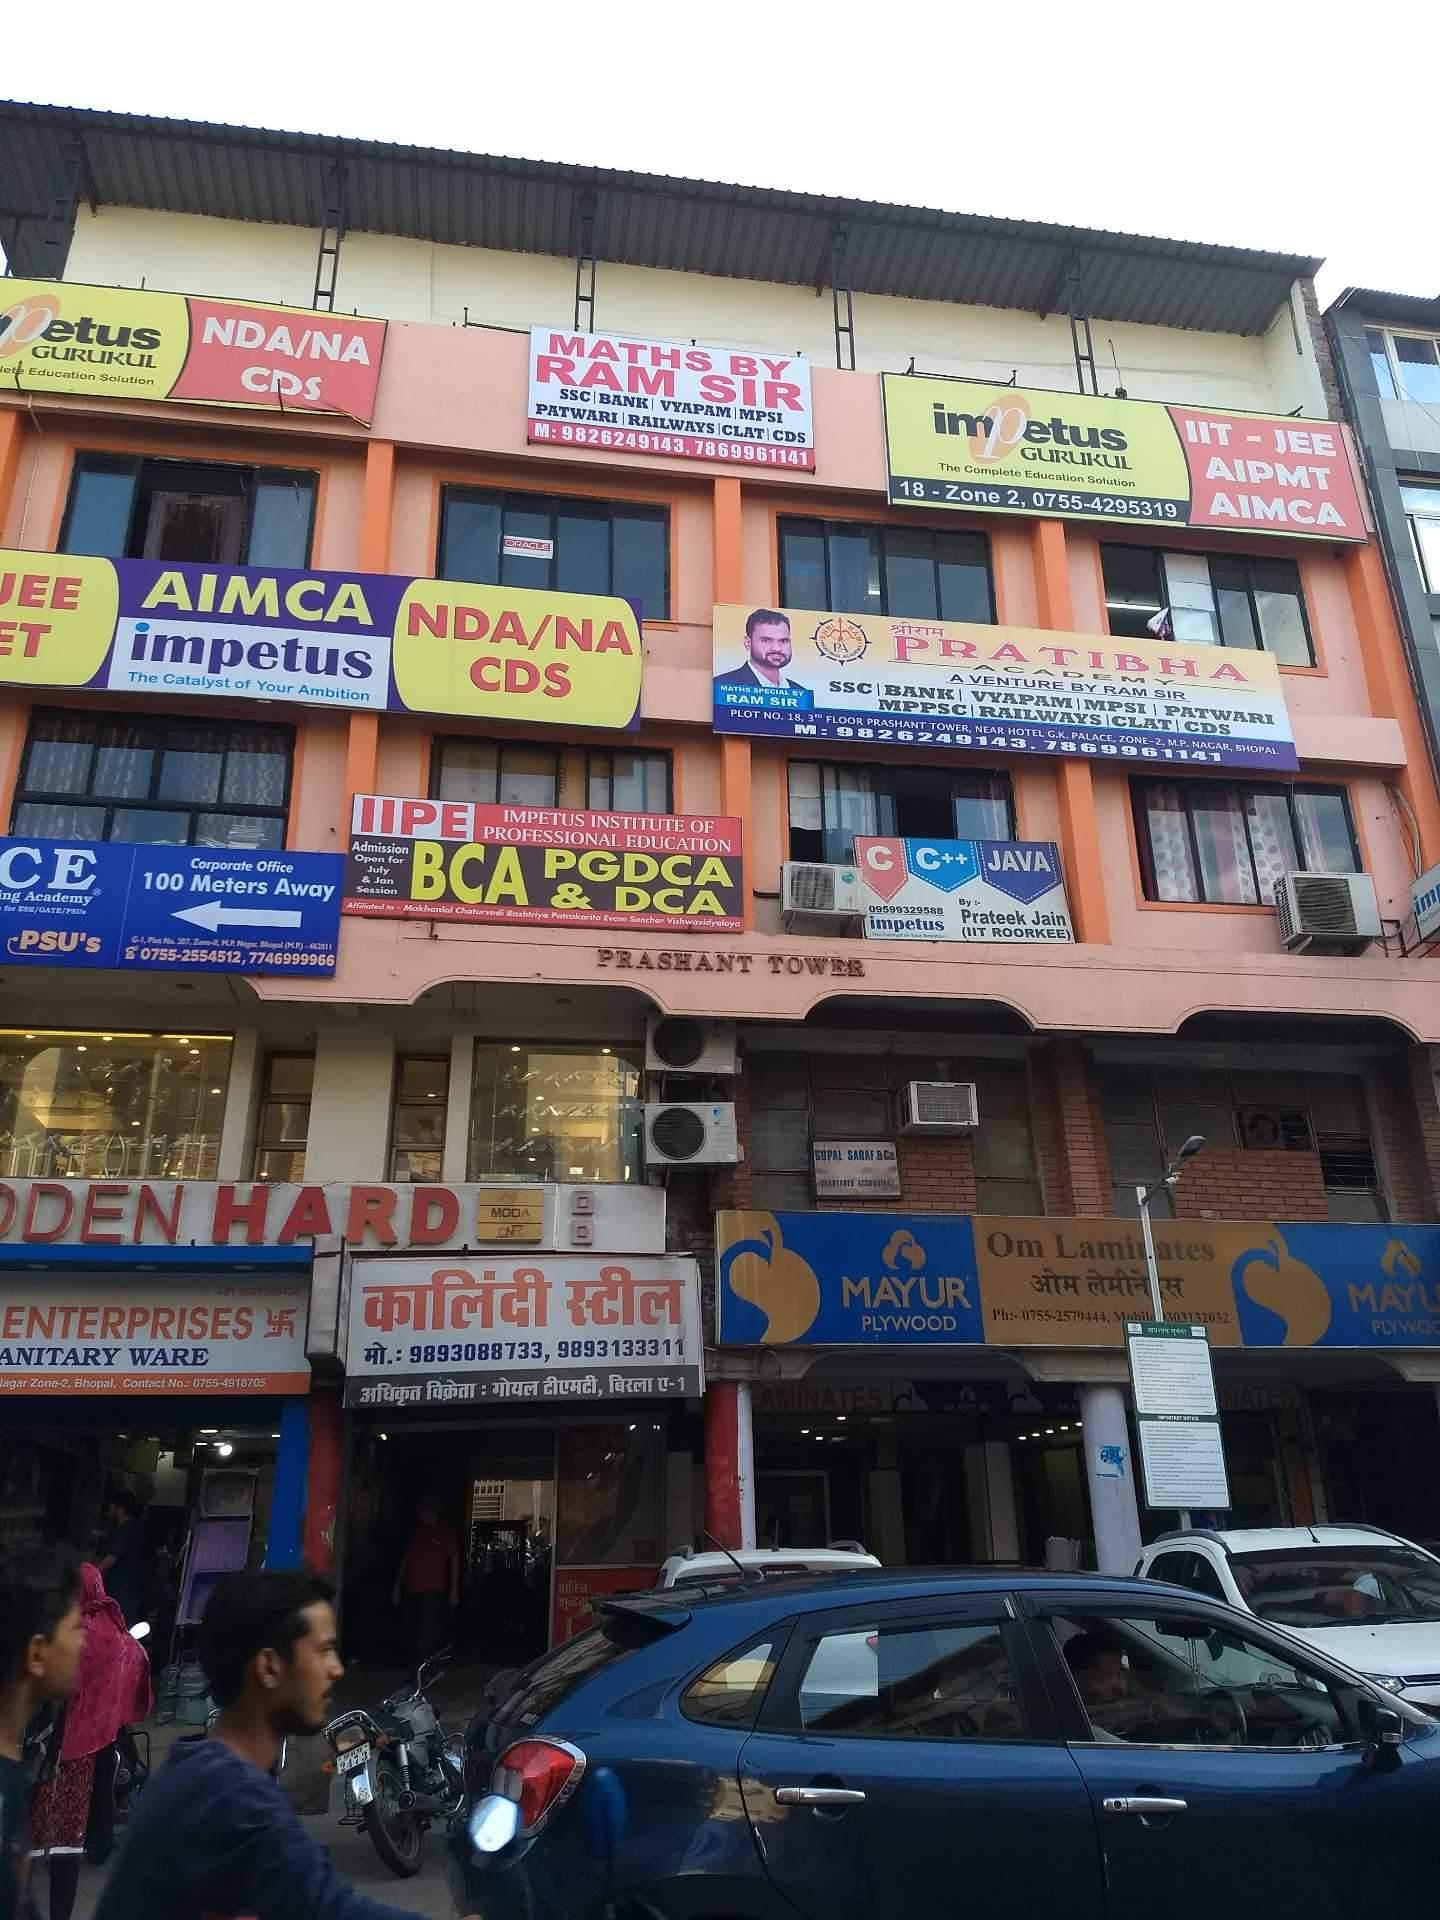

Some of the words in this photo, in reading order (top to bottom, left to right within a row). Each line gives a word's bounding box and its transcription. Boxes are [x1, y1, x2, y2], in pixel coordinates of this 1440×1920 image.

[201, 317, 370, 365] NDA/NA
[31, 345, 157, 368] GURUKUL
[549, 334, 712, 372] MATHS
[730, 355, 791, 380] BY
[29, 367, 95, 381] Education
[100, 373, 154, 385] Solution
[241, 366, 323, 400] CDS
[536, 354, 675, 398] RAM
[700, 374, 804, 411] SIR
[559, 388, 591, 402] SSC
[599, 392, 649, 409] BANK
[660, 399, 731, 419] VYAPAM
[739, 408, 783, 424] MPSI
[535, 403, 617, 424] PATWARI
[628, 413, 715, 434] RAILWAYS
[722, 424, 765, 441] CLAT
[773, 430, 806, 444] CDS
[932, 402, 1128, 459] impetus
[534, 421, 556, 439] M:
[562, 424, 690, 455] 9826249143,
[695, 439, 808, 466] 7869961141
[1184, 419, 1232, 446] IIT
[1275, 427, 1337, 457] JEE
[1020, 446, 1132, 471] GURUKUL
[938, 461, 960, 474] The
[963, 465, 1021, 480] Complete
[1025, 469, 1084, 484] Education
[1086, 475, 1136, 488] Solution
[1205, 456, 1331, 490] AIPMT
[899, 480, 924, 498] 18
[945, 484, 1000, 505] Zone
[1006, 489, 1026, 508] 2,
[1032, 491, 1178, 519] 0755-4295319
[1209, 492, 1347, 528] AIMCA
[504, 539, 551, 551] ORACLE
[141, 571, 374, 626] AIMCA
[407, 602, 633, 655] NDA/NA
[890, 622, 944, 638] श्रीराम
[130, 622, 374, 679] impetus
[892, 635, 1249, 682] PRATIBHA
[128, 671, 158, 683] The
[163, 673, 231, 689] Catalyst
[235, 678, 251, 689] of
[256, 680, 294, 695] Your
[299, 684, 370, 701] Ambition
[469, 656, 572, 698] CDS
[950, 674, 964, 683] A
[969, 675, 1064, 691] VENTURE
[1070, 682, 1098, 693] BY
[1104, 685, 1147, 697] RAM
[1154, 689, 1187, 700] SIR
[973, 664, 1176, 686] ACADEMY
[720, 685, 751, 693] MATHS
[753, 687, 789, 696] SPECIAL
[726, 694, 764, 705] RAM
[769, 696, 798, 707] SIR
[829, 680, 873, 695] SSC
[885, 684, 954, 701] BANK
[971, 690, 1073, 709] VYAPAM
[1085, 699, 1147, 715] MPSI
[1164, 706, 1275, 726] PATWARI
[878, 699, 967, 716] MPPSC
[979, 705, 1101, 726] RAILWAYS
[1111, 715, 1172, 731] CLAT
[1184, 720, 1231, 736] CDS
[730, 709, 760, 719] PLOT
[763, 711, 784, 721] NO.
[788, 713, 805, 723] 18,
[826, 715, 863, 726] FLOOR
[866, 718, 928, 730] PRASHANT
[930, 722, 972, 734] TOWER,
[975, 725, 1005, 735] NEAR
[1008, 728, 1044, 739] HOTEL
[1071, 732, 1117, 744] PALACE,
[1192, 740, 1232, 752] NAGAR,
[1235, 744, 1279, 755] BHOPAL
[1044, 739, 1222, 762] 7869961141
[360, 798, 469, 839] IIPE
[502, 809, 585, 828] IMPETUS
[590, 814, 686, 834] INSTITUTE
[690, 820, 715, 834] OF
[352, 840, 409, 855] Admission
[482, 825, 621, 848] PROFESSIONAL
[625, 833, 732, 853] EDUCATION
[190, 857, 253, 874] Corporate
[256, 860, 294, 874] Office
[354, 854, 385, 864] Open
[388, 856, 405, 864] for
[367, 865, 390, 875] July
[544, 848, 734, 888] PGDCA
[866, 845, 893, 871] C
[916, 846, 967, 871] C++
[987, 850, 1051, 872] JAVA
[143, 871, 184, 892] 100
[190, 874, 268, 895] Meters
[274, 878, 336, 902] Away
[361, 876, 371, 884] &
[374, 876, 394, 885] Jan
[410, 840, 529, 906] BCA
[356, 885, 398, 895] Session
[550, 883, 594, 910] &
[616, 886, 727, 916] DCA
[959, 898, 972, 907] By
[346, 902, 385, 911] Affiliated
[455, 905, 505, 917] Chaturvedi
[507, 910, 549, 920] Rashtriya
[551, 911, 601, 922] Patrakarita
[604, 914, 628, 923] Evam
[630, 915, 665, 925] Sanchar
[667, 917, 741, 928] Vishwavidyalaya
[869, 915, 945, 932] impetus
[961, 909, 1025, 926] Prateek
[1031, 910, 1067, 927] Jain
[19, 929, 102, 953] PSU's
[961, 926, 989, 940] (IIT
[992, 927, 1071, 942] ROORKEE)
[249, 952, 336, 967] 7746999966
[597, 949, 752, 973] PRASHANT
[768, 955, 866, 977] TOWER
[815, 1149, 843, 1161] GOPAL
[847, 1149, 876, 1161] SARAF
[211, 1184, 459, 1246] HARD
[987, 1231, 1044, 1258] Om
[362, 1268, 553, 1333] कालिंदी
[565, 1266, 686, 1327] स्टील
[842, 1276, 972, 1309] MAYUR
[2, 1306, 254, 1341] ENTERPRISES
[862, 1314, 957, 1332] PLYWOOD
[1022, 1309, 1110, 1324] 0755-2579444,
[128, 1347, 209, 1366] WARE
[409, 1341, 550, 1364] 9893088733,
[558, 1338, 685, 1358] 9893133311
[30, 1377, 71, 1389] Zone-2,
[74, 1377, 117, 1390] Bhopal,
[122, 1377, 165, 1389] Contact
[192, 1377, 266, 1389] 0755-4918705
[360, 1383, 421, 1407] अधिकृत
[427, 1379, 476, 1402] विक्रेता
[493, 1376, 537, 1398] गोयल
[609, 1375, 651, 1395] बिरला
